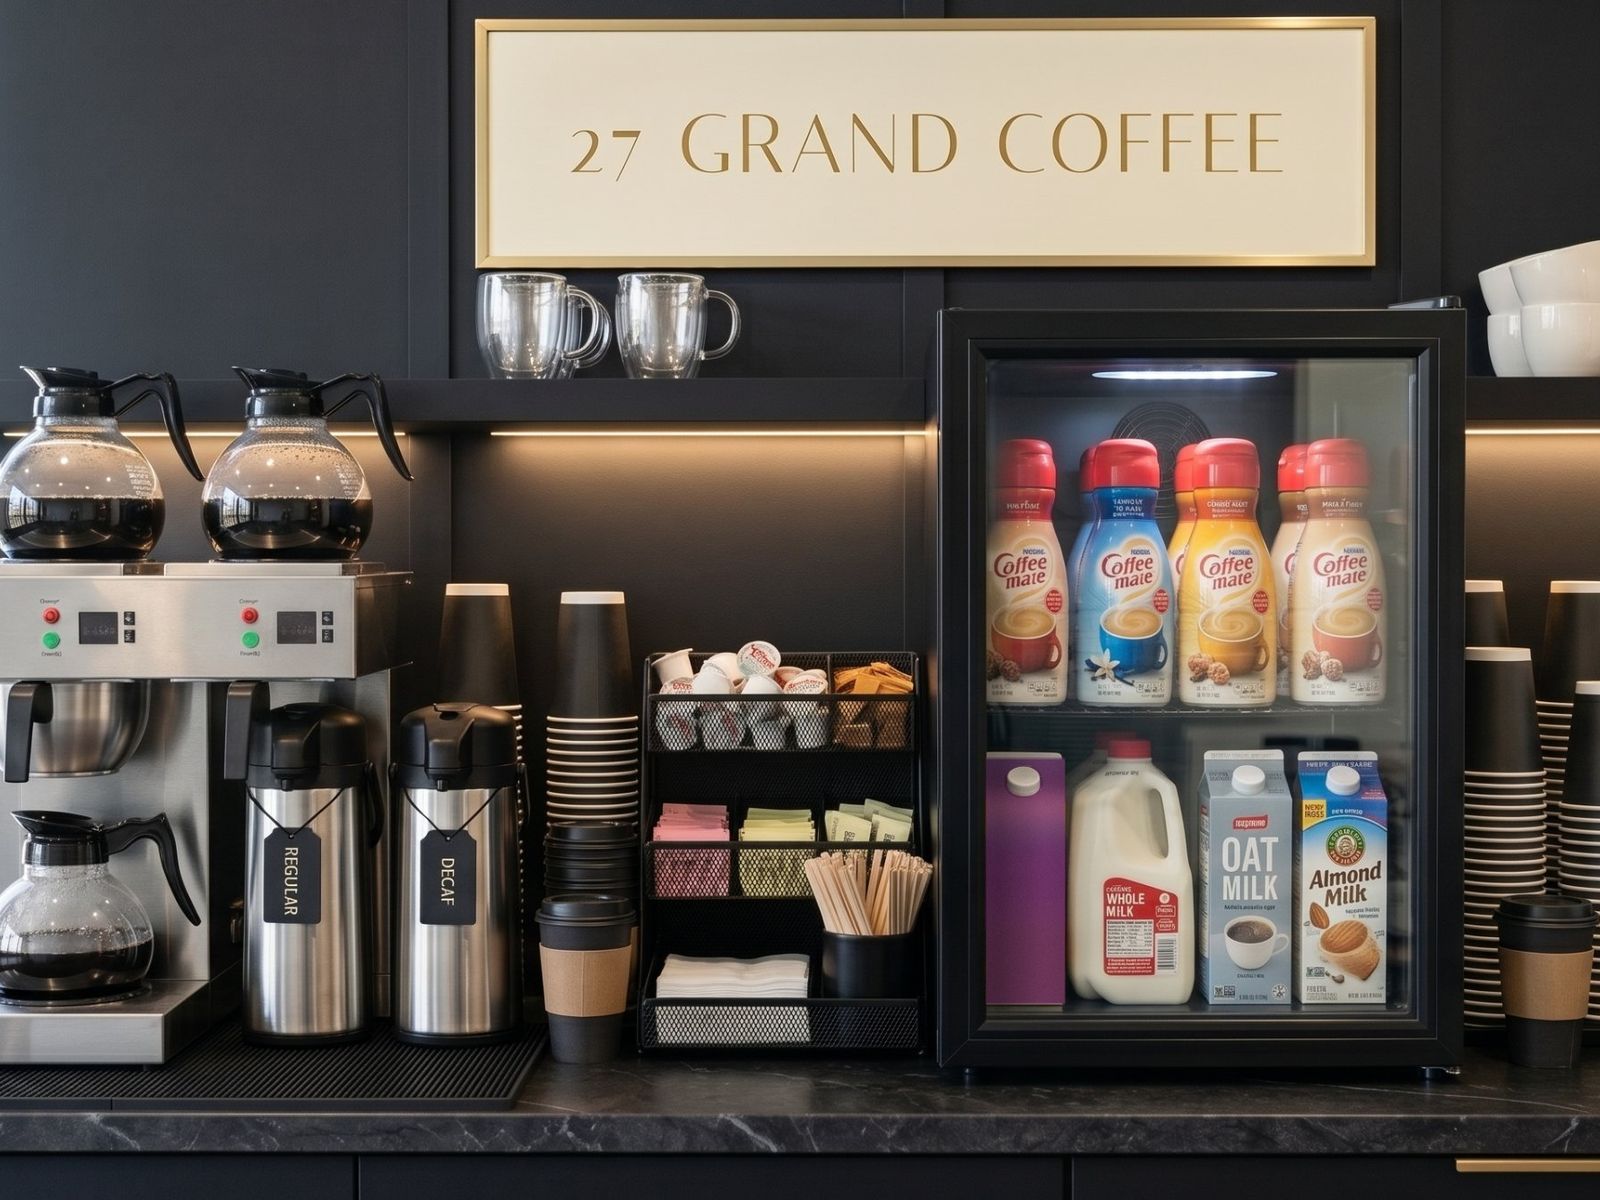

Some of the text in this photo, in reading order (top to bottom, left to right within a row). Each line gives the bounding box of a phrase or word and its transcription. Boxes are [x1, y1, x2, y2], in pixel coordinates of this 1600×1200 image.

[570, 112, 1284, 182] 27 GRAND COFFEE
[994, 553, 1047, 578] Coffee
[1101, 553, 1153, 578] Coffee
[1199, 553, 1254, 579] Coffee
[1313, 551, 1368, 577] Coffee
[1212, 571, 1253, 590] mate
[1326, 570, 1367, 588] mate
[1222, 836, 1279, 873] OAT
[284, 847, 299, 916] REGULAR
[441, 857, 455, 906] DECAF
[1222, 874, 1278, 900] MILK
[1309, 861, 1382, 890] Almond
[1106, 892, 1145, 905] WHOLE
[1325, 884, 1367, 908] Milk
[1106, 905, 1133, 918] MILK
